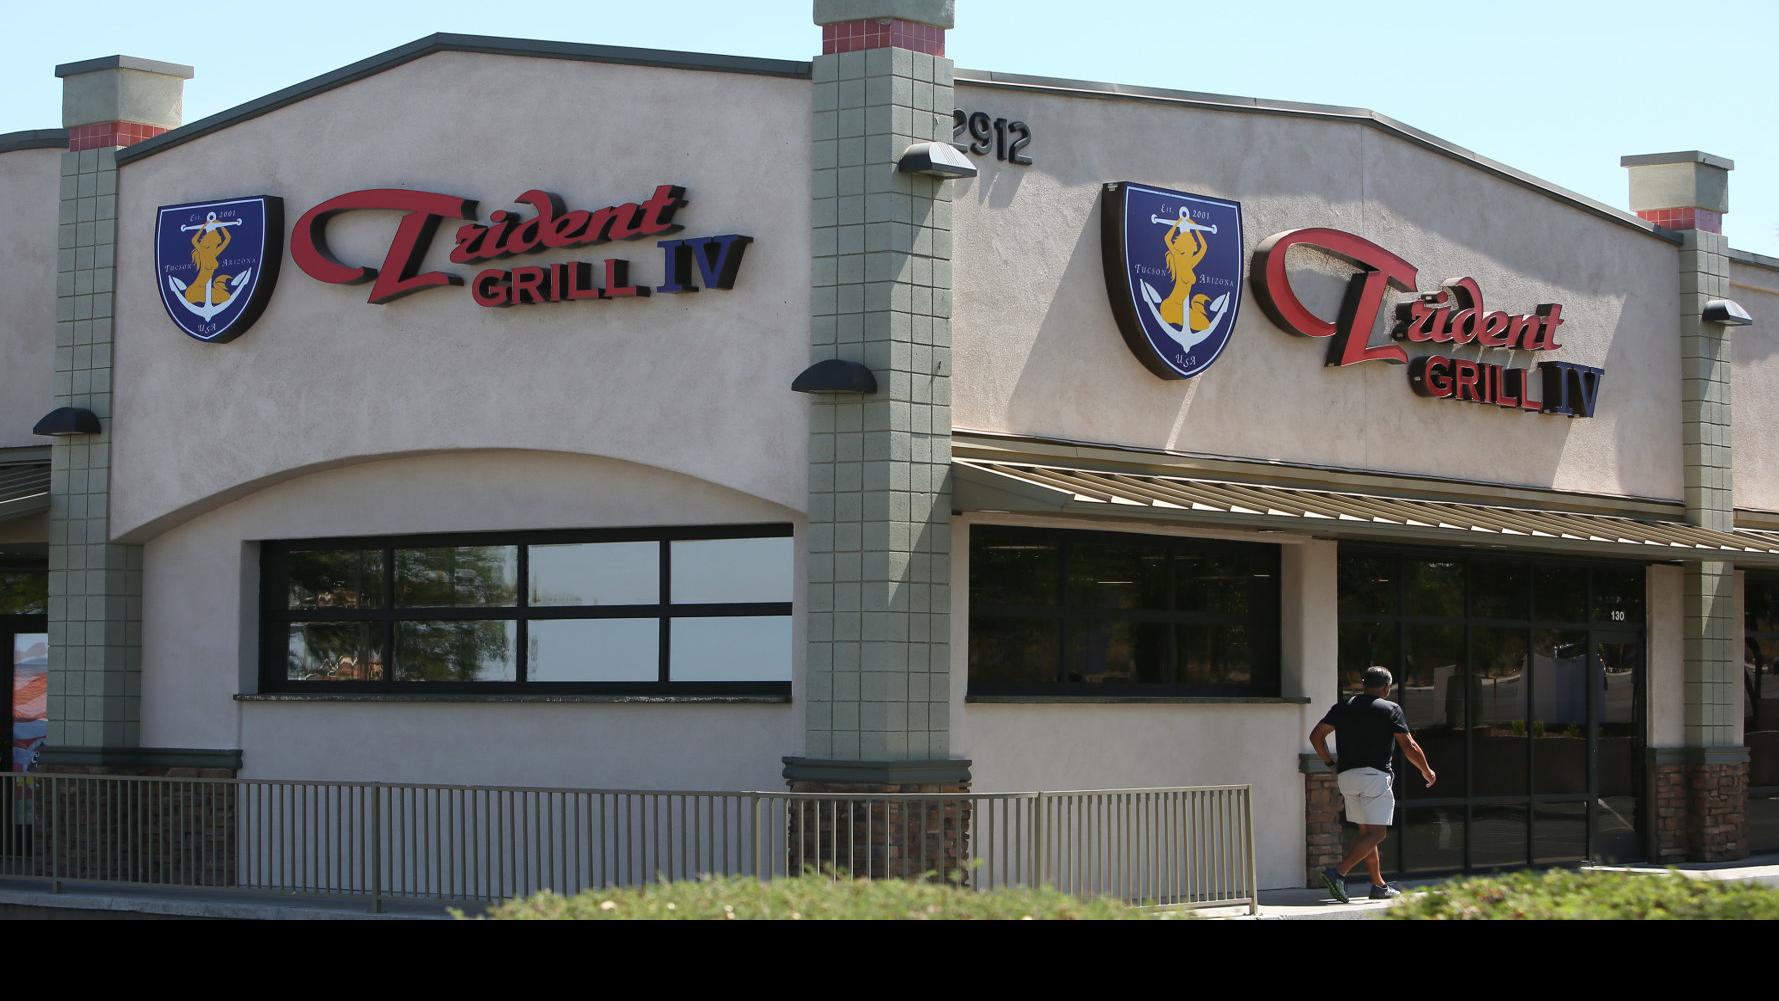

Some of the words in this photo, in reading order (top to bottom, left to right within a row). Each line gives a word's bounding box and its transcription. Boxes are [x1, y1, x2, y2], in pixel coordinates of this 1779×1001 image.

[953, 108, 1032, 166] 2912
[290, 184, 685, 304] Trident
[471, 258, 646, 307] GRILL
[657, 234, 750, 294] IV
[1254, 227, 1564, 367] Trident
[197, 323, 216, 334] USA
[1175, 353, 1197, 368] USA
[1418, 354, 1542, 411] GRILL
[1547, 361, 1604, 418] IV
[1611, 610, 1625, 621] 130
